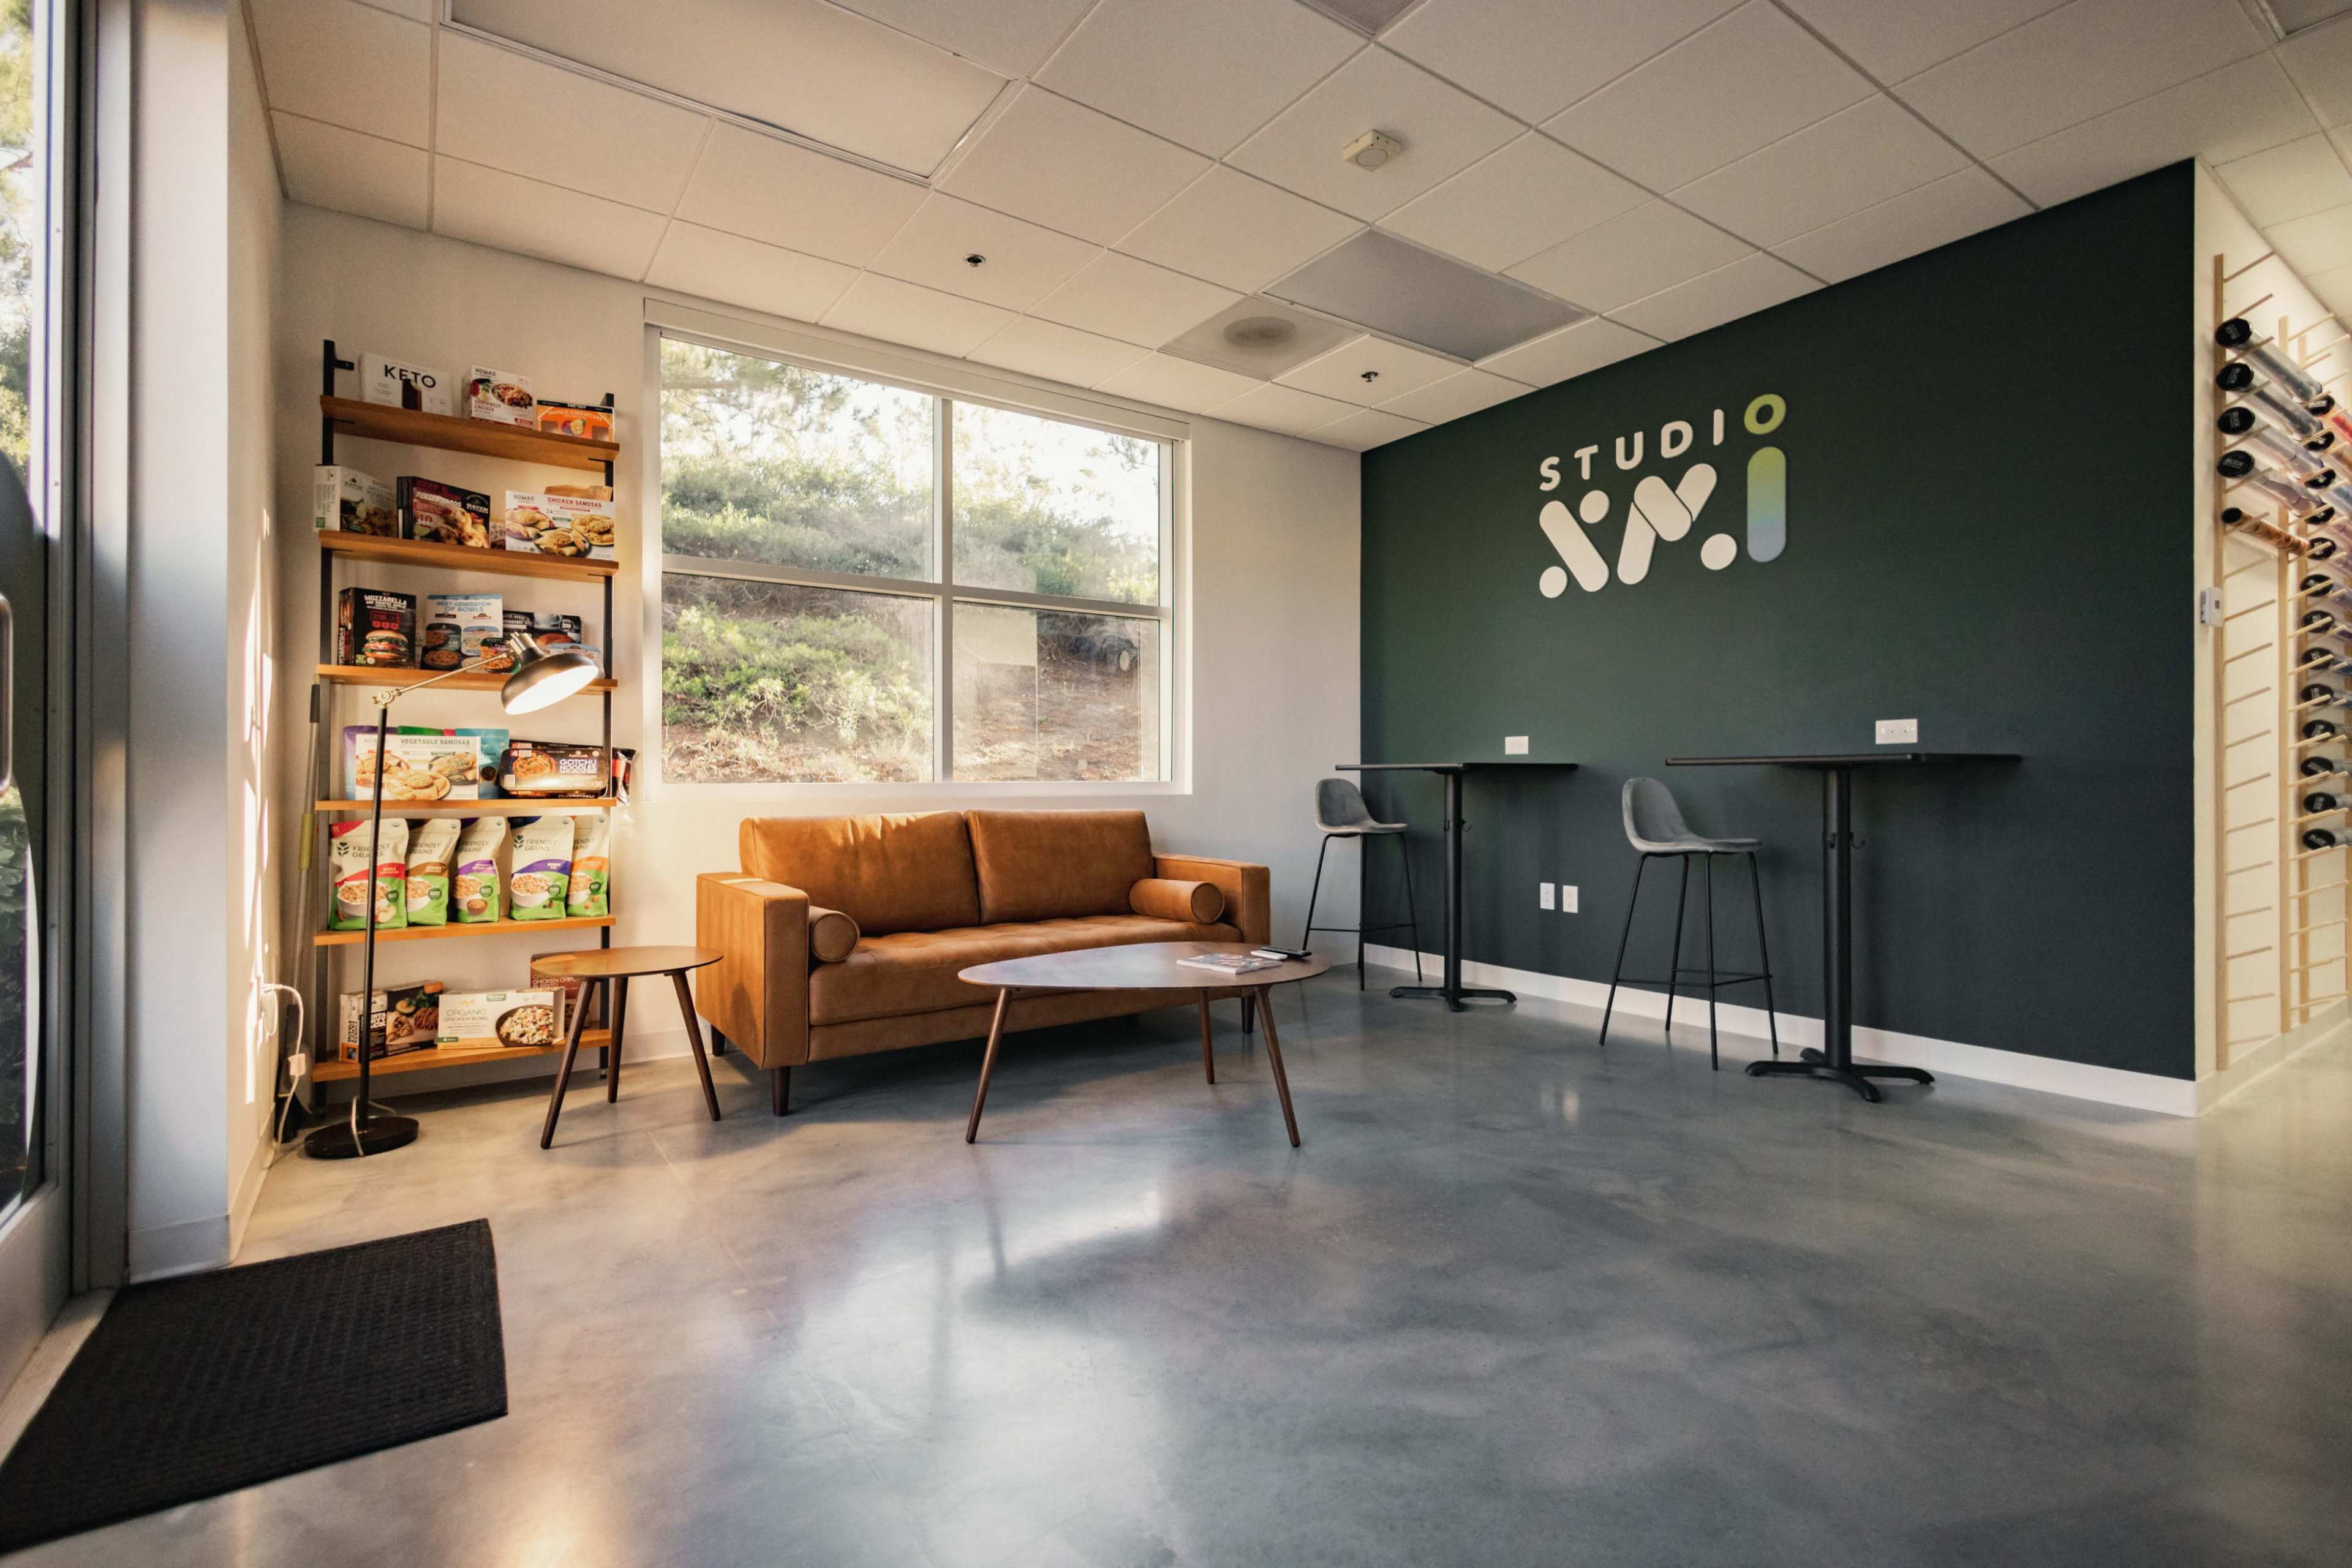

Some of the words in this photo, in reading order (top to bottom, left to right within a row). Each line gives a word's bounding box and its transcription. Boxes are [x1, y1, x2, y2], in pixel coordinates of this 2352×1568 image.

[384, 364, 436, 388] KETO
[1539, 394, 1787, 491] STUDIO
[364, 595, 407, 605] MOZZARELLA
[353, 843, 391, 851] FRIEDLY
